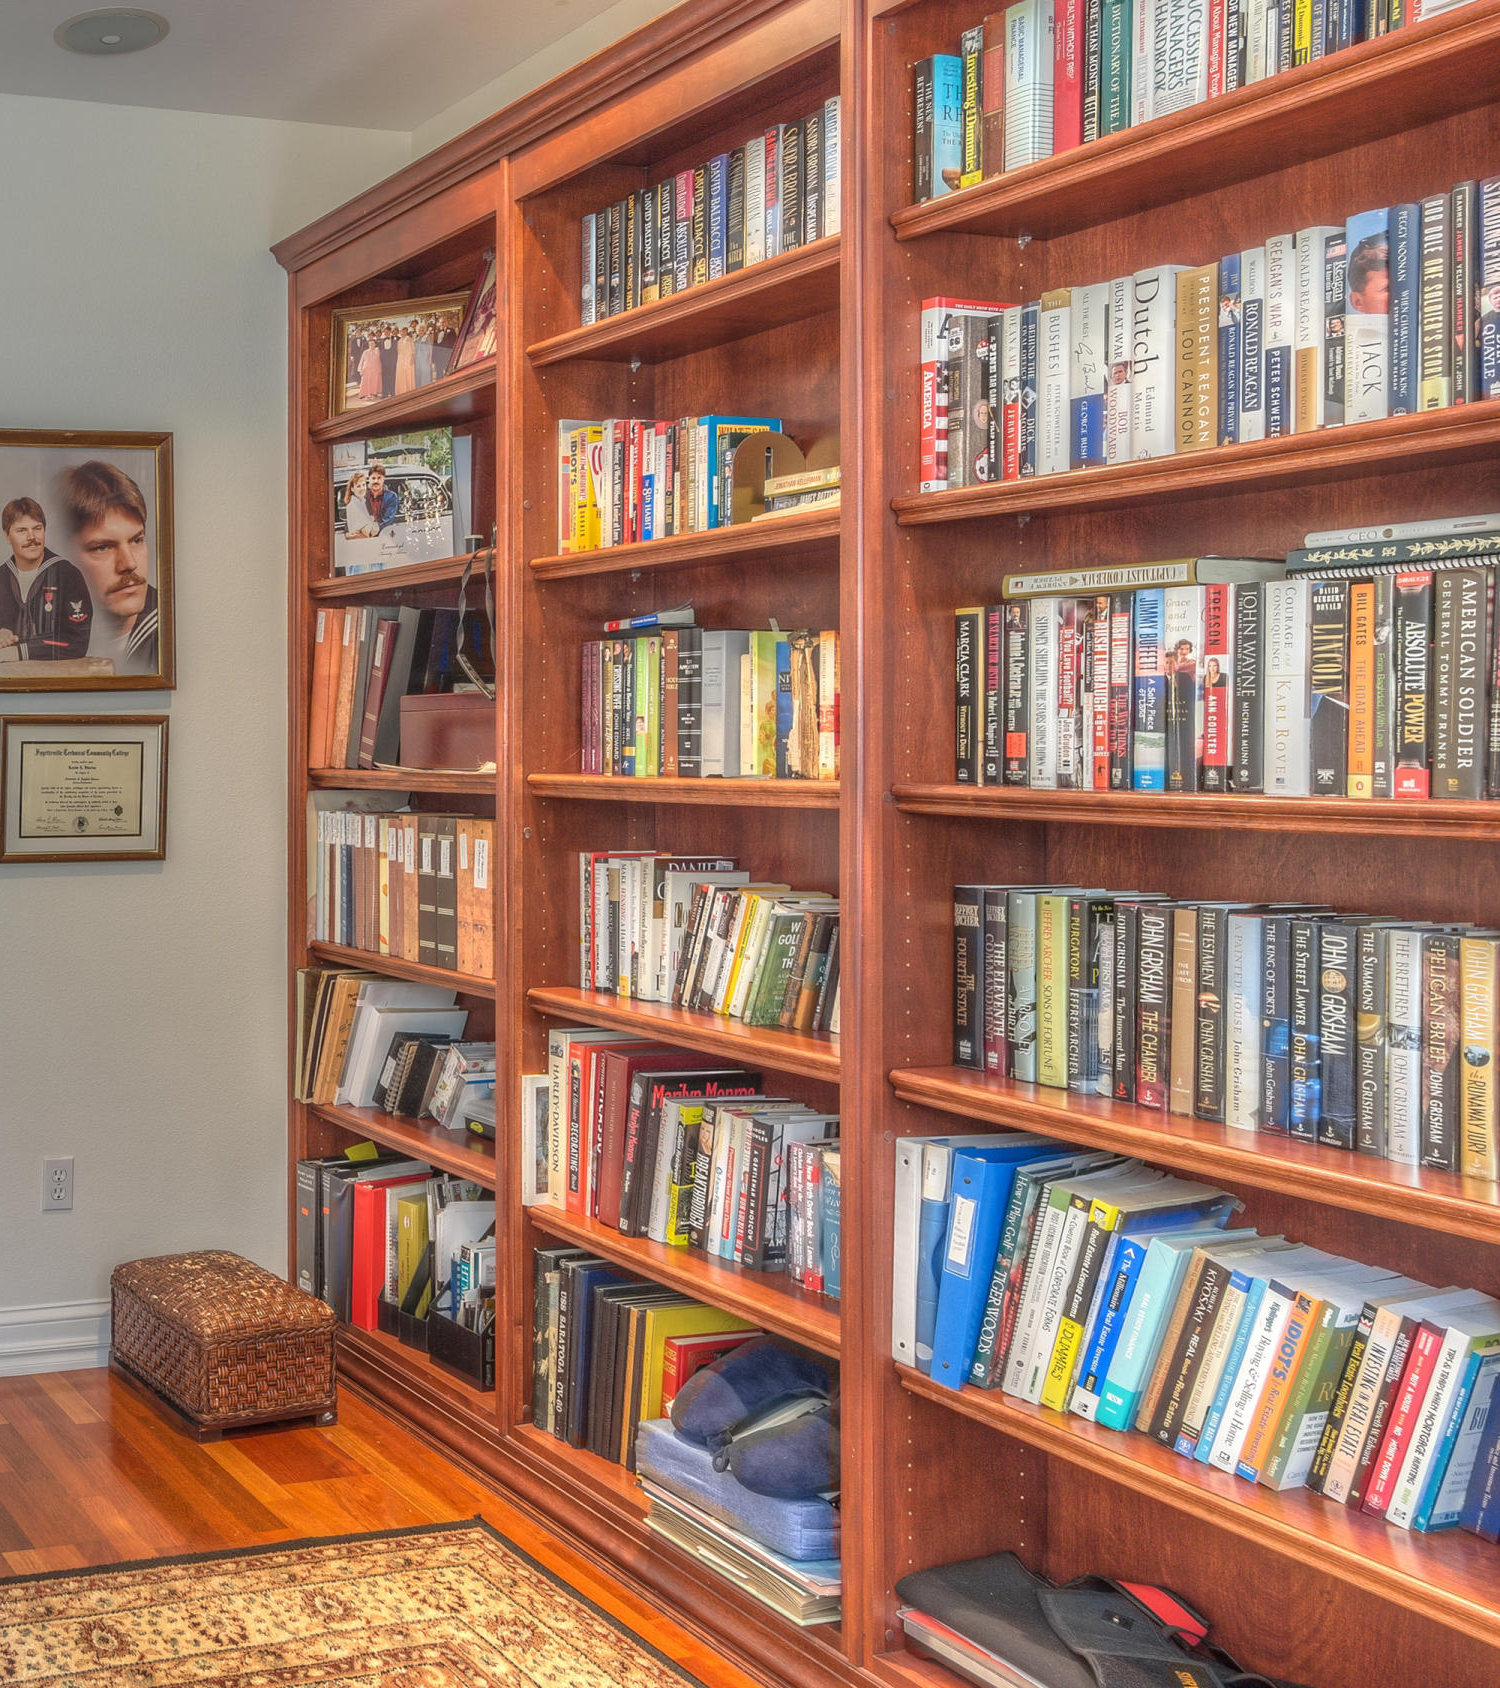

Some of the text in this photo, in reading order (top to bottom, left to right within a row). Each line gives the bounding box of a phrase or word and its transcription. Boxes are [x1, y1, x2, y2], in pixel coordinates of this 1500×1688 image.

[1110, 4, 1122, 122] DICTIONARY OF THE
[1154, 5, 1166, 94] HANDBOOK
[916, 76, 924, 134] RETIREMENT
[925, 81, 933, 121] THE NEW
[965, 52, 978, 171] Investing Dummies
[783, 128, 798, 217] SANDRA BROWN
[826, 101, 837, 181] SANDRA BROWN
[710, 161, 721, 251] DAVID BALDACCI
[1270, 241, 1282, 327] REAGAN'S WAR
[1333, 261, 1346, 301] Reagan
[1397, 211, 1408, 281] PEGGY NOONAN
[1113, 283, 1124, 359] BUSH AT WAR
[1134, 275, 1160, 375] Dutch
[1423, 200, 1443, 380] BOB DOLE ONE SOLDIER'S STORY
[1049, 315, 1060, 369] BUSHES
[1198, 276, 1211, 442] PRESIDENT REAGAN
[1244, 302, 1259, 408] RONALD REAGAN
[1361, 341, 1382, 396] JACK
[1399, 290, 1409, 397] WHEN CHARACTER WAS KING
[923, 370, 934, 429] AMERICA
[1108, 388, 1117, 459] WOODWARD
[1118, 411, 1127, 433] BOB
[1134, 392, 1142, 431] Morris
[1145, 386, 1155, 432] Edmund
[1181, 328, 1194, 445] LOU CANNON
[1348, 531, 1377, 542] CEO
[1035, 616, 1048, 687] SIDNEY SHELDON
[1139, 598, 1158, 671] JIMMY BUFFETT
[1209, 590, 1221, 646] TREASON
[1240, 592, 1258, 697] JOHN WAYNE
[1271, 588, 1281, 670] CONSEQUENCE
[1283, 587, 1297, 648] COURAGE
[1356, 592, 1367, 646] BILL GATES
[613, 665, 622, 692] CROSSING
[960, 622, 970, 697] MARCIA CLARK
[1094, 621, 1108, 712] RUSH LIMBAUGH
[1312, 623, 1344, 695] LINCOLN
[1404, 620, 1426, 744] ABSOLUTE POWER
[1437, 580, 1452, 769] GENERAL TOMMY FRANKS
[1457, 579, 1477, 769] AMERICAN SOLDIER
[613, 693, 622, 710] OVER
[1207, 695, 1217, 754] ANN COULTER
[1241, 702, 1250, 765] MICHAEL MUNN
[1275, 680, 1291, 774] KARL ROVE
[1355, 660, 1366, 753] THE ROAD AHEAD
[113, 748, 129, 757] College
[1069, 917, 1080, 1075] PURGATORY JEFFREY ARCHER
[1140, 913, 1165, 1003] JOHN GRISHAM
[1295, 928, 1310, 1026] THE STREET LAWYER
[1321, 932, 1347, 1055] JOHN GRISHAM
[1198, 912, 1215, 1092] THE TESTAMENT JOHN GRISHAM
[1361, 932, 1377, 1129] THE SUMMONS JOHN GRISHAM
[1141, 1011, 1159, 1083] THE CHAMBER
[1429, 948, 1446, 1143] PELICAN BRIEF JOHN GRISHAM
[551, 1064, 561, 1172] HARLEY-DAVIDSON
[569, 1122, 579, 1171] DECORATING
[626, 1109, 640, 1163] Marilyn Monroe
[690, 1154, 710, 1230] BREAKTHROUGH
[805, 1152, 814, 1237] The New Birth Order Book
[1006, 1205, 1022, 1225] Play
[1014, 1176, 1028, 1199] How
[1002, 1226, 1019, 1251] Golf
[1069, 1229, 1100, 1319] Real Estate License Exams
[977, 1271, 1007, 1355] TIGER WOODS
[1090, 1259, 1132, 1373] The Millionaire Real Estate Investor
[1193, 1269, 1217, 1324] KIYOSAKI
[556, 1315, 566, 1374] SARATOGA
[1051, 1330, 1075, 1381] DUMMIES
[1273, 1319, 1305, 1380] IDIOT'S
[555, 1381, 564, 1413] CV-60
[1339, 1343, 1387, 1459] INVESTING IN REAL ESTATE
